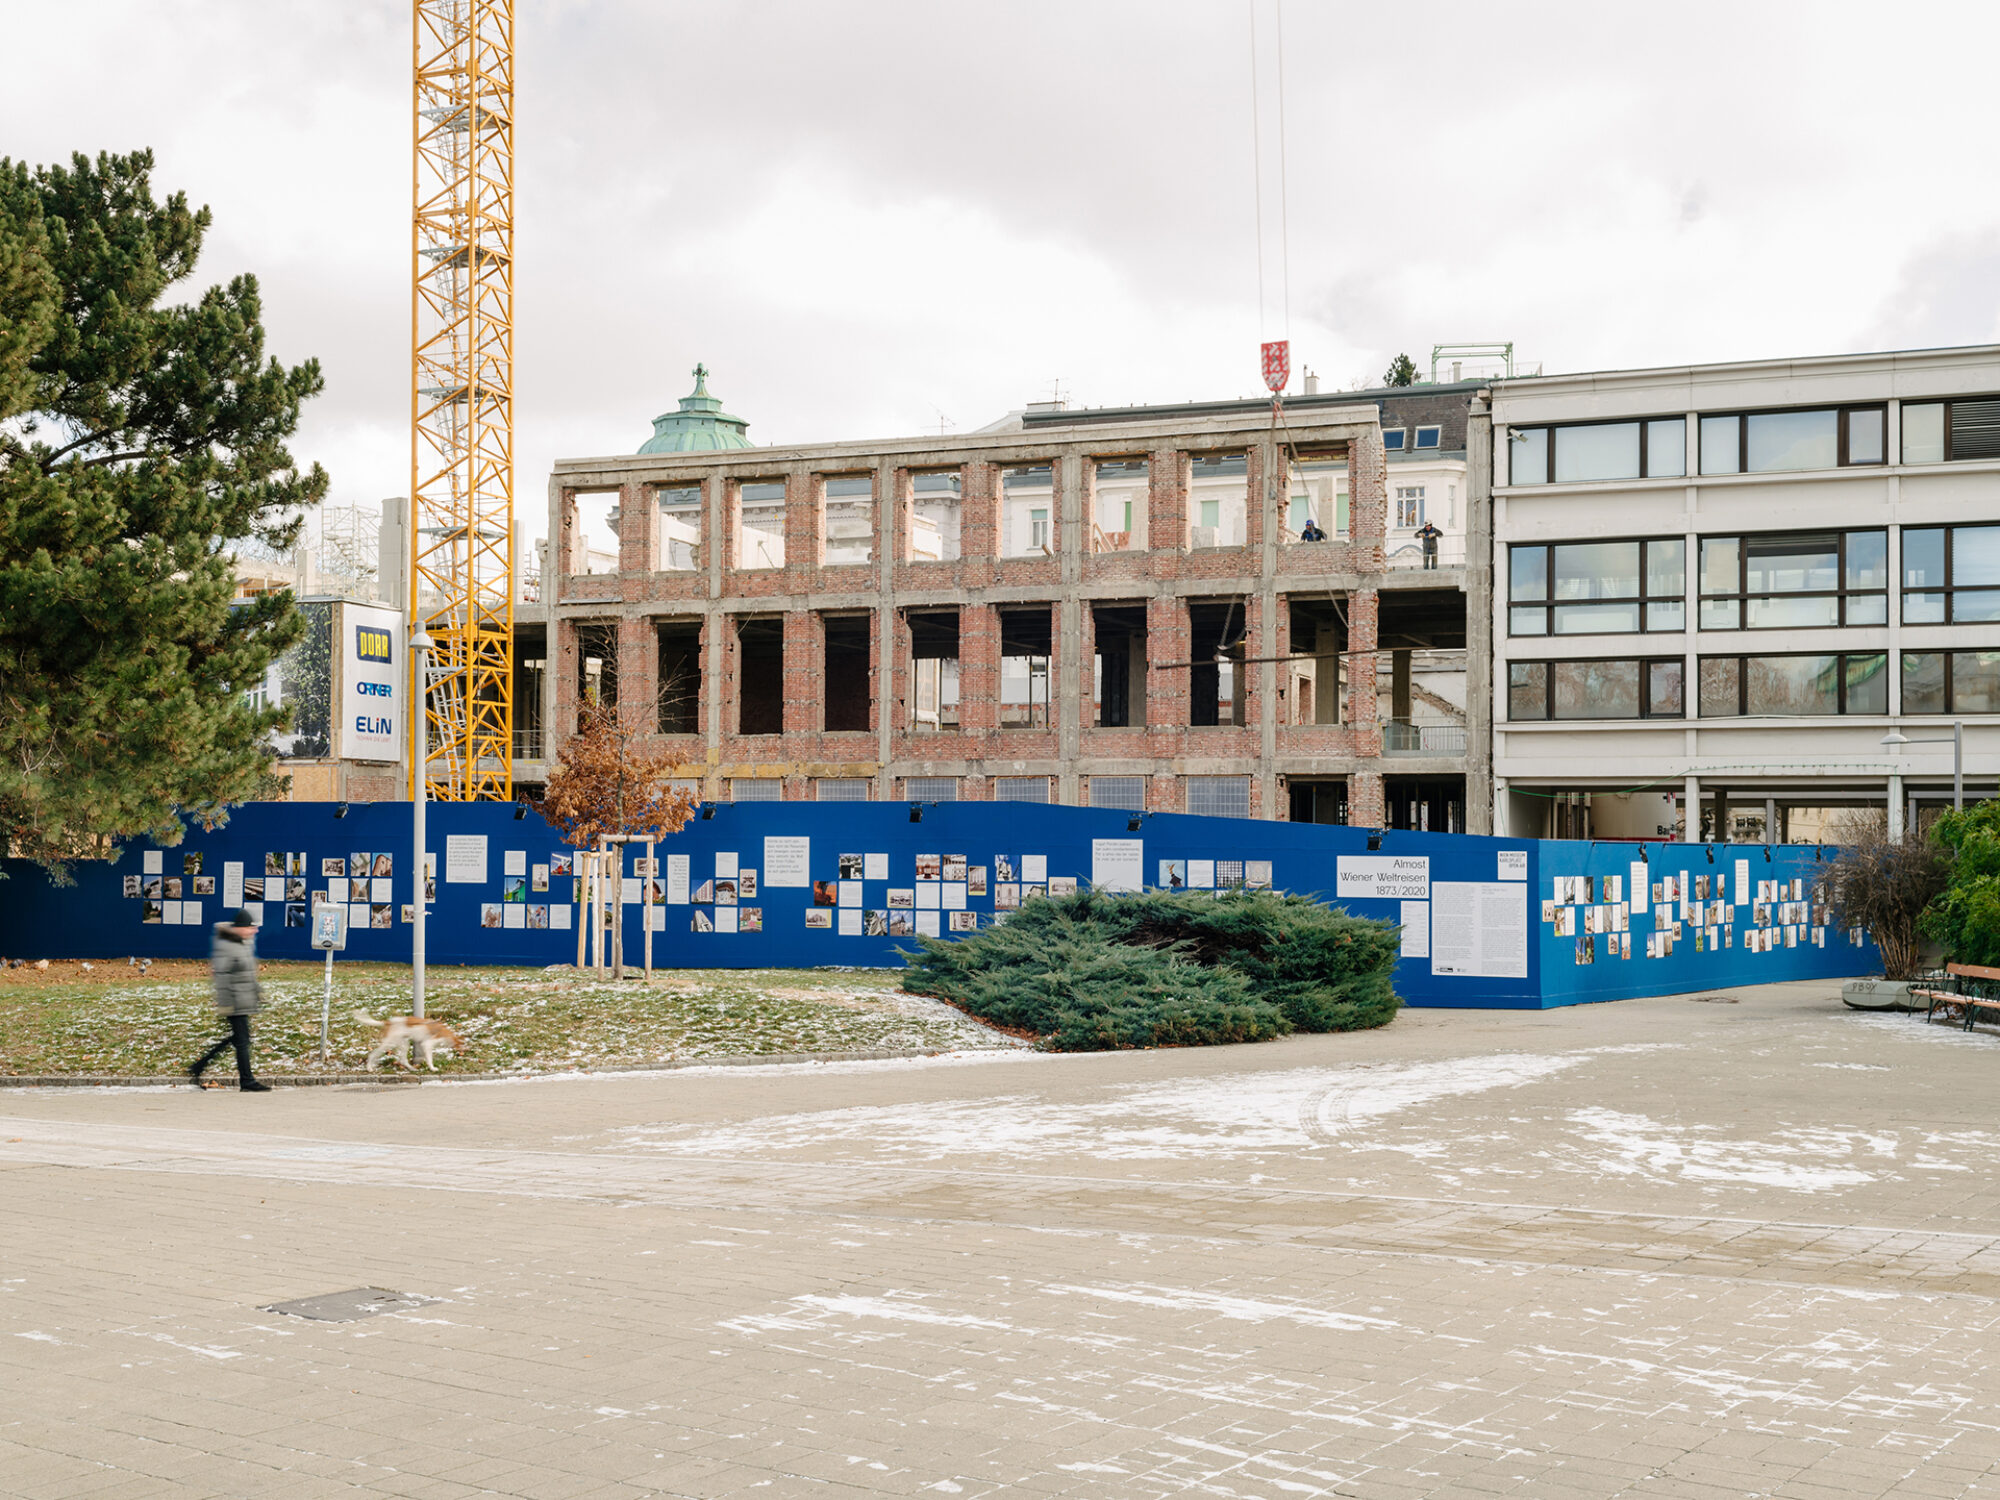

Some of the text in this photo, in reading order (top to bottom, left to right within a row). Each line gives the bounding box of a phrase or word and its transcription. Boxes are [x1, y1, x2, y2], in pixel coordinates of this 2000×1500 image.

[360, 631, 389, 658] PORR
[356, 681, 392, 698] ORTNER
[1393, 859, 1426, 869] Almost
[1340, 872, 1426, 882] Wiener Weltreisen
[1376, 886, 1426, 896] 1873/2020
